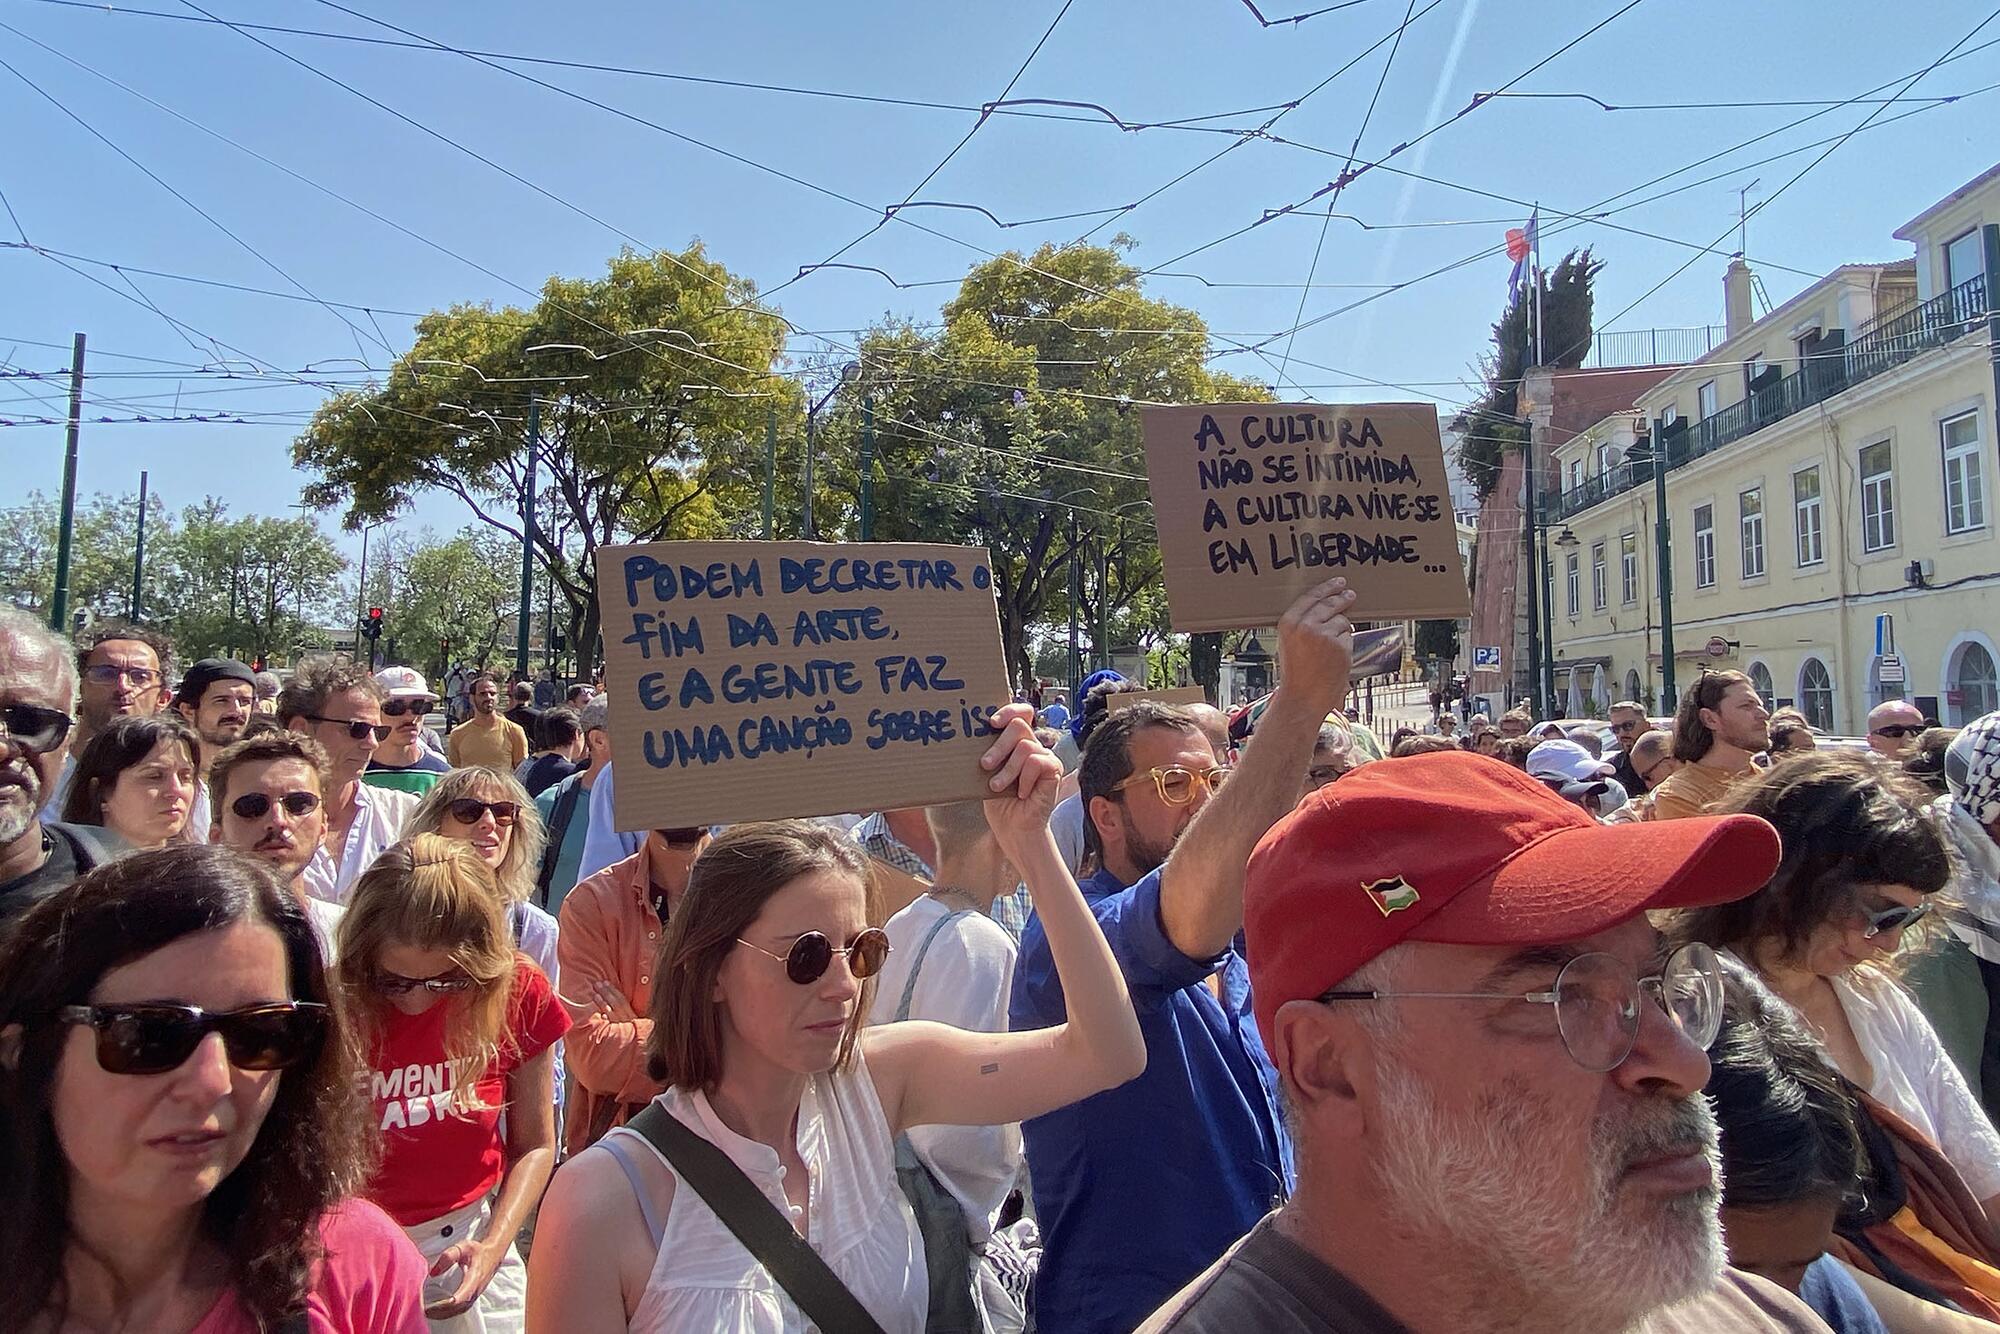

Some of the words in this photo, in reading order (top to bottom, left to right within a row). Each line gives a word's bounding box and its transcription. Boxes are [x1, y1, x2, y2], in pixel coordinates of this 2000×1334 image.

[1194, 414, 1226, 451] A
[1241, 414, 1383, 450] CULTURA
[1198, 448, 1253, 490] NÃO
[1263, 455, 1298, 484] SE
[1202, 498, 1228, 532] A
[1237, 492, 1354, 525] CULTURA
[1208, 538, 1259, 576] EM
[623, 555, 764, 608] PODEM
[780, 557, 963, 594] DECRETAR
[973, 565, 991, 590] O
[727, 612, 779, 649] DA
[787, 606, 899, 647] ARTE,
[875, 655, 965, 694] FAZ
[1477, 648, 1488, 661] P
[643, 725, 734, 769] UMA
[737, 700, 852, 759] CANÇÃO
[866, 709, 956, 751] SOBRE
